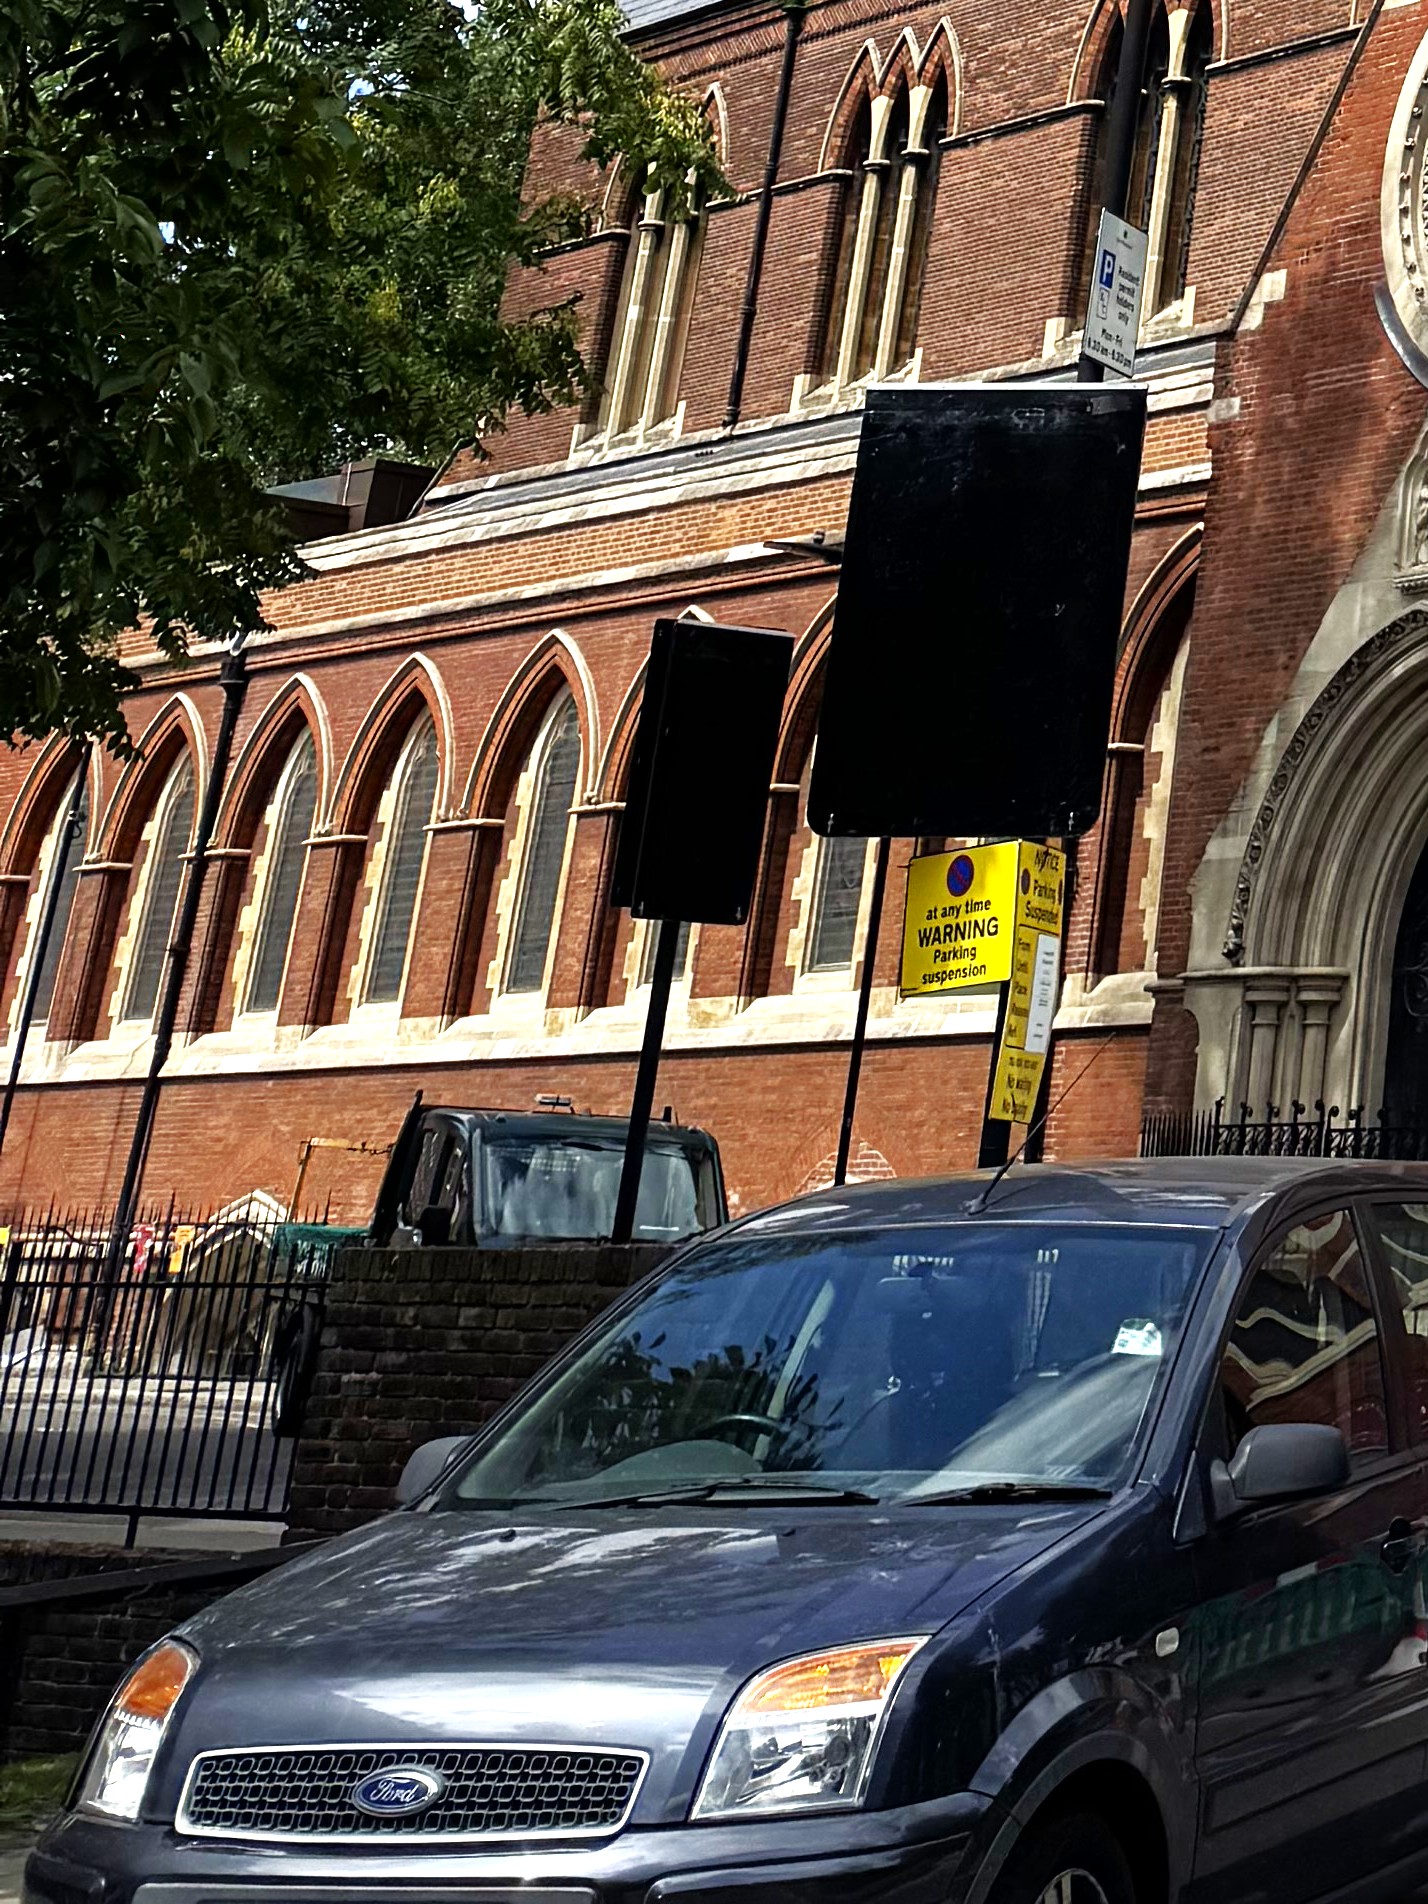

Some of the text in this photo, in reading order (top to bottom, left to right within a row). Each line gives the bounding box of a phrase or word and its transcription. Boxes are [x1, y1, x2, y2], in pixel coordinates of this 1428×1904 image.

[1033, 879, 1056, 904] Parking
[926, 899, 991, 921] at any time
[918, 916, 999, 948] WARNING
[934, 946, 976, 964] Parking
[922, 964, 986, 985] suspension
[369, 1777, 420, 1802] Ford
